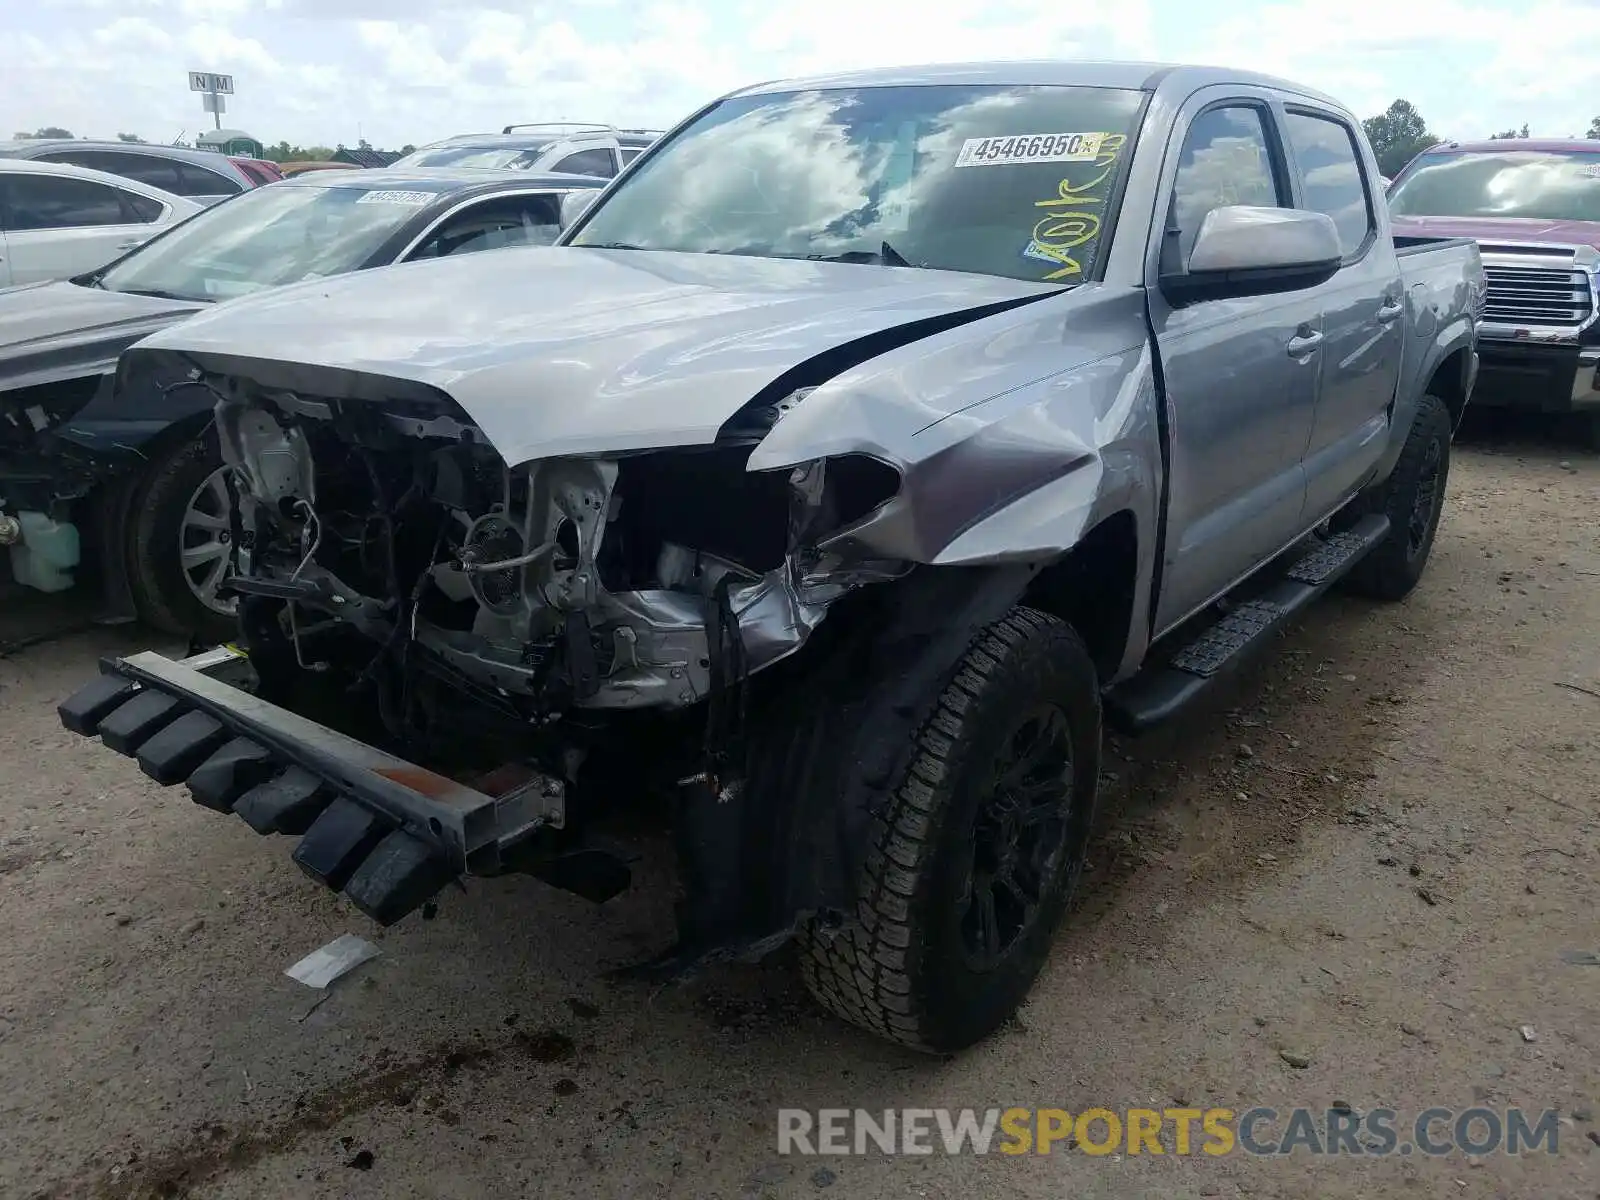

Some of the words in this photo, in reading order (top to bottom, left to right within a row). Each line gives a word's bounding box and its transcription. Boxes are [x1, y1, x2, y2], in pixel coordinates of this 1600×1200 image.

[195, 76, 206, 89] N
[216, 77, 228, 91] M
[974, 134, 1083, 160] 45466950
